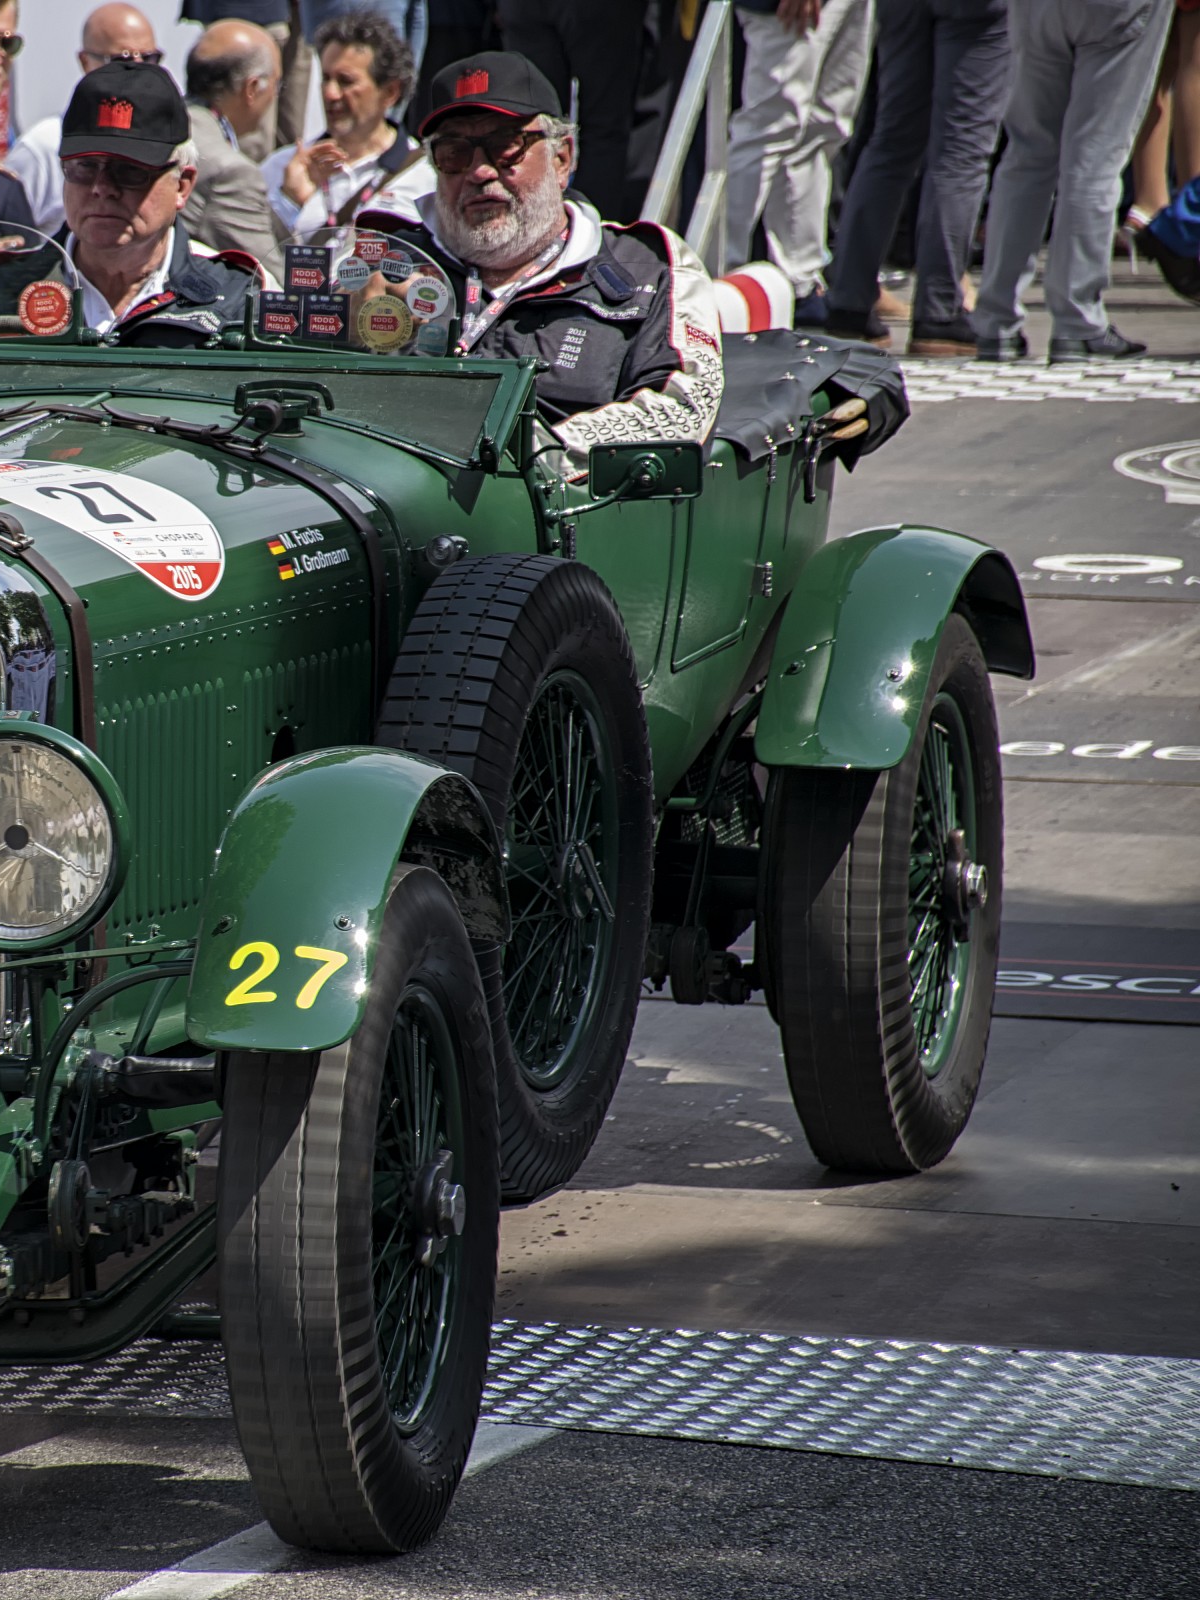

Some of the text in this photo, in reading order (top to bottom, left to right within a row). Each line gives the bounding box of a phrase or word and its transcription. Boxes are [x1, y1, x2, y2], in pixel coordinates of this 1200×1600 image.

[360, 243, 383, 254] 2015
[292, 257, 325, 265] verificato
[266, 303, 298, 311] verificato
[310, 303, 343, 311] verificato
[314, 316, 335, 324] 1000
[267, 322, 291, 330] MIGLIA
[567, 328, 587, 336] 2011
[687, 327, 712, 343] 1000
[563, 335, 584, 344] 2012
[560, 344, 581, 353] 2013
[557, 352, 578, 361] 2014
[554, 359, 576, 369] 2015
[652, 404, 676, 438] 2010
[668, 405, 690, 433] 2009
[36, 482, 157, 523] 27
[155, 533, 203, 542] CHOPARD
[278, 527, 324, 549] M. Fuchs
[292, 548, 350, 575] J. Großmann
[166, 565, 202, 589] 2015
[998, 741, 1200, 762] ede
[225, 942, 348, 1009] 27
[996, 970, 1200, 995] esc
